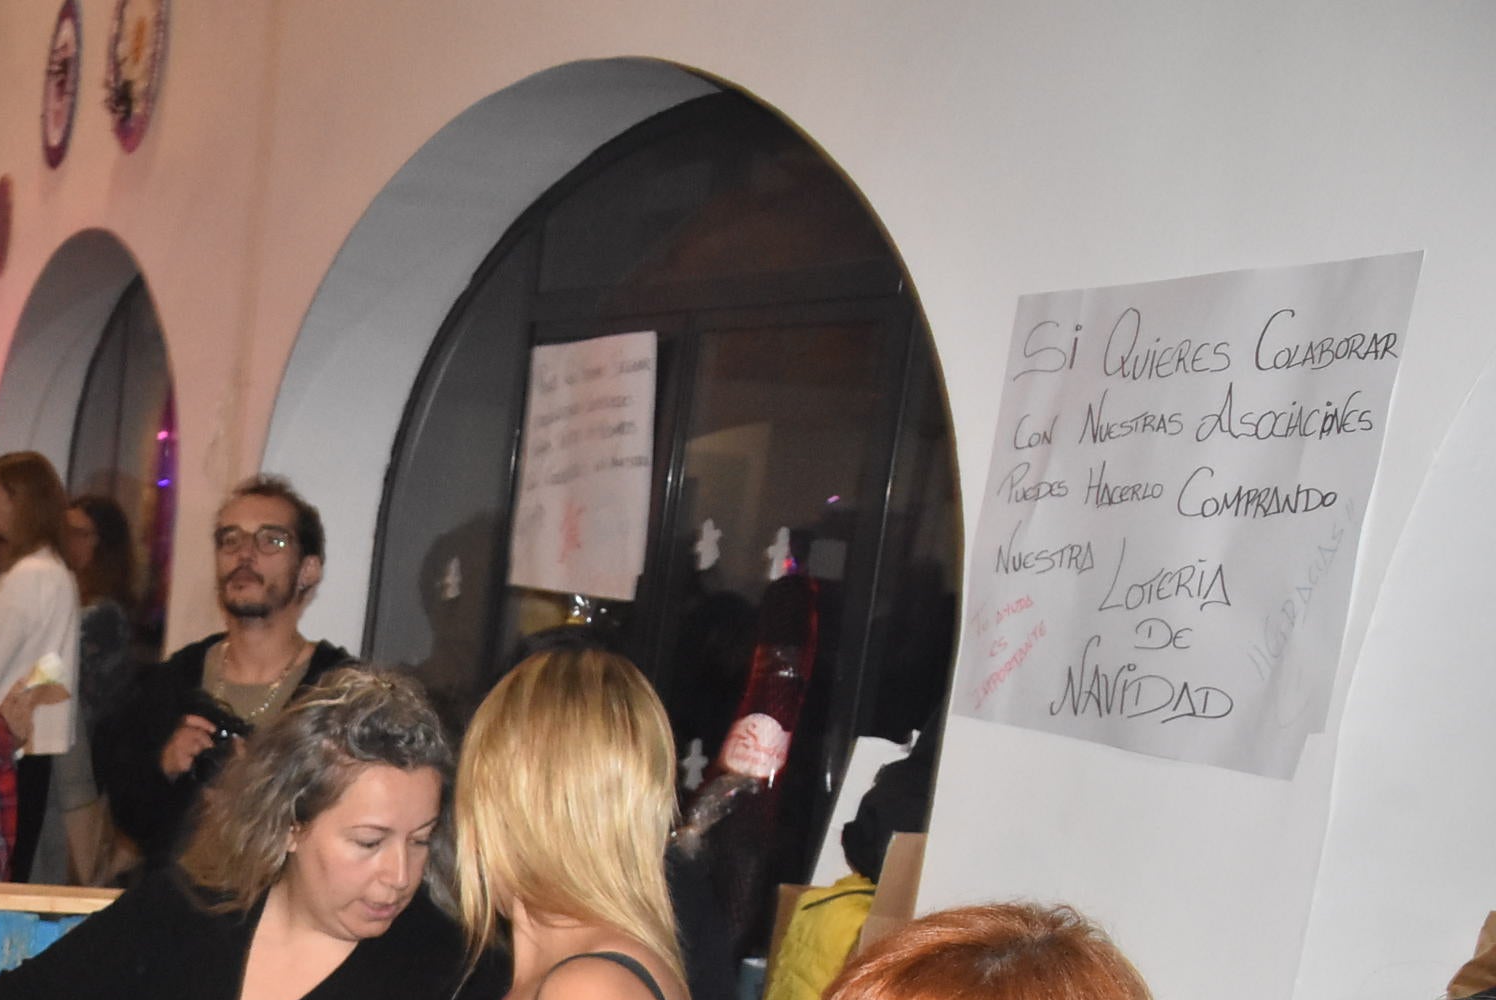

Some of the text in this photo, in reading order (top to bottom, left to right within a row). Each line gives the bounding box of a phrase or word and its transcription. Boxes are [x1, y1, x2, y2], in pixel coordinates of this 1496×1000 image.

[1103, 306, 1232, 380] QUIERES
[1255, 308, 1399, 372] COLABORAR
[1013, 413, 1058, 450] CON
[1078, 388, 1184, 446] NUESTRAS
[997, 460, 1338, 519] PUEDES HACERLO COMPRANDO
[995, 519, 1095, 575] NUESTRA
[1134, 617, 1194, 650] DE
[1049, 634, 1235, 725] NAVIDAD
